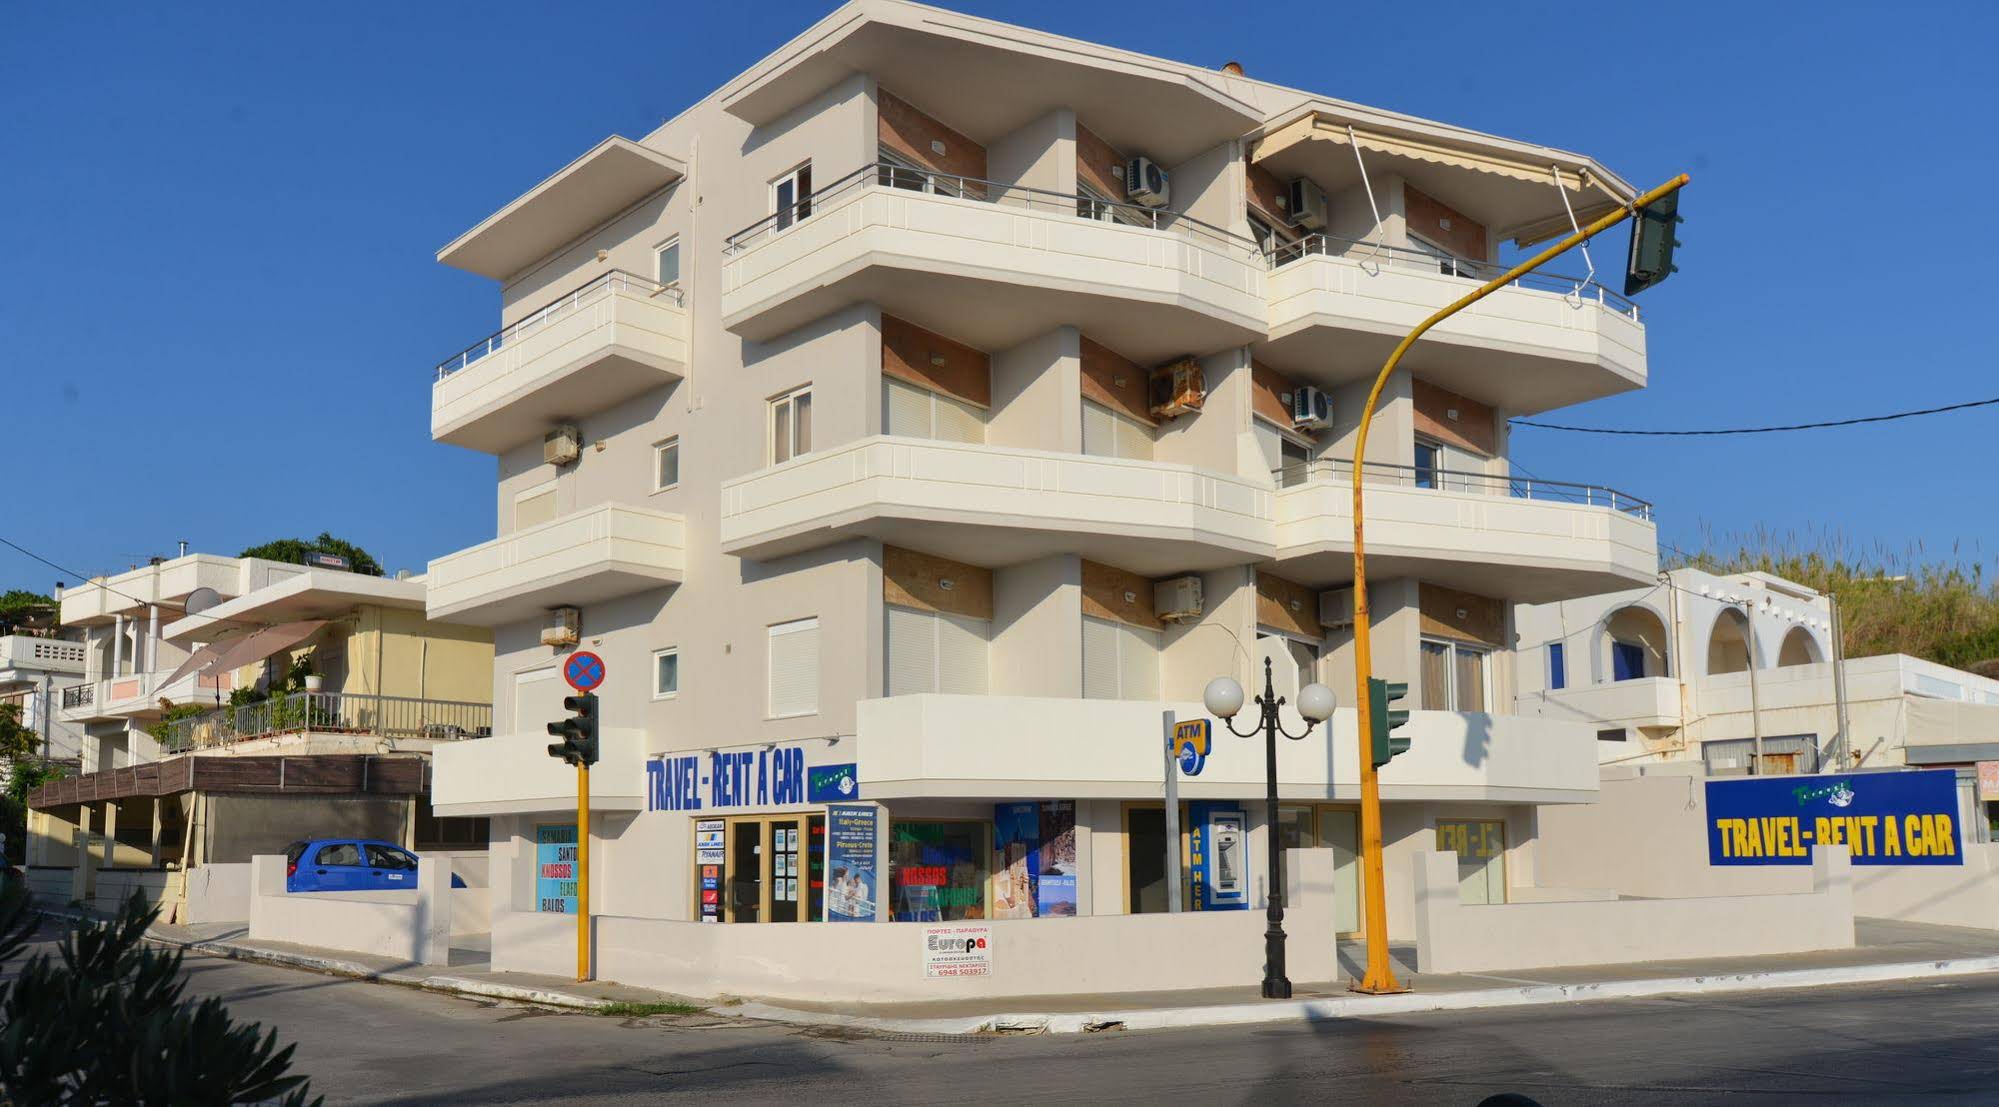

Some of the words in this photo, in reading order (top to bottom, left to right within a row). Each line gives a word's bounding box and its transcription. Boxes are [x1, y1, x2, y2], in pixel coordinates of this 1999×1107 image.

[1177, 724, 1201, 739] ATM
[757, 750, 768, 805] A
[773, 747, 803, 805] CAR
[1884, 815, 1901, 857] A
[1905, 814, 1956, 856] CAR
[541, 863, 572, 879] KNOSSOS
[542, 898, 564, 913] BALOS
[928, 935, 986, 953] Europa
